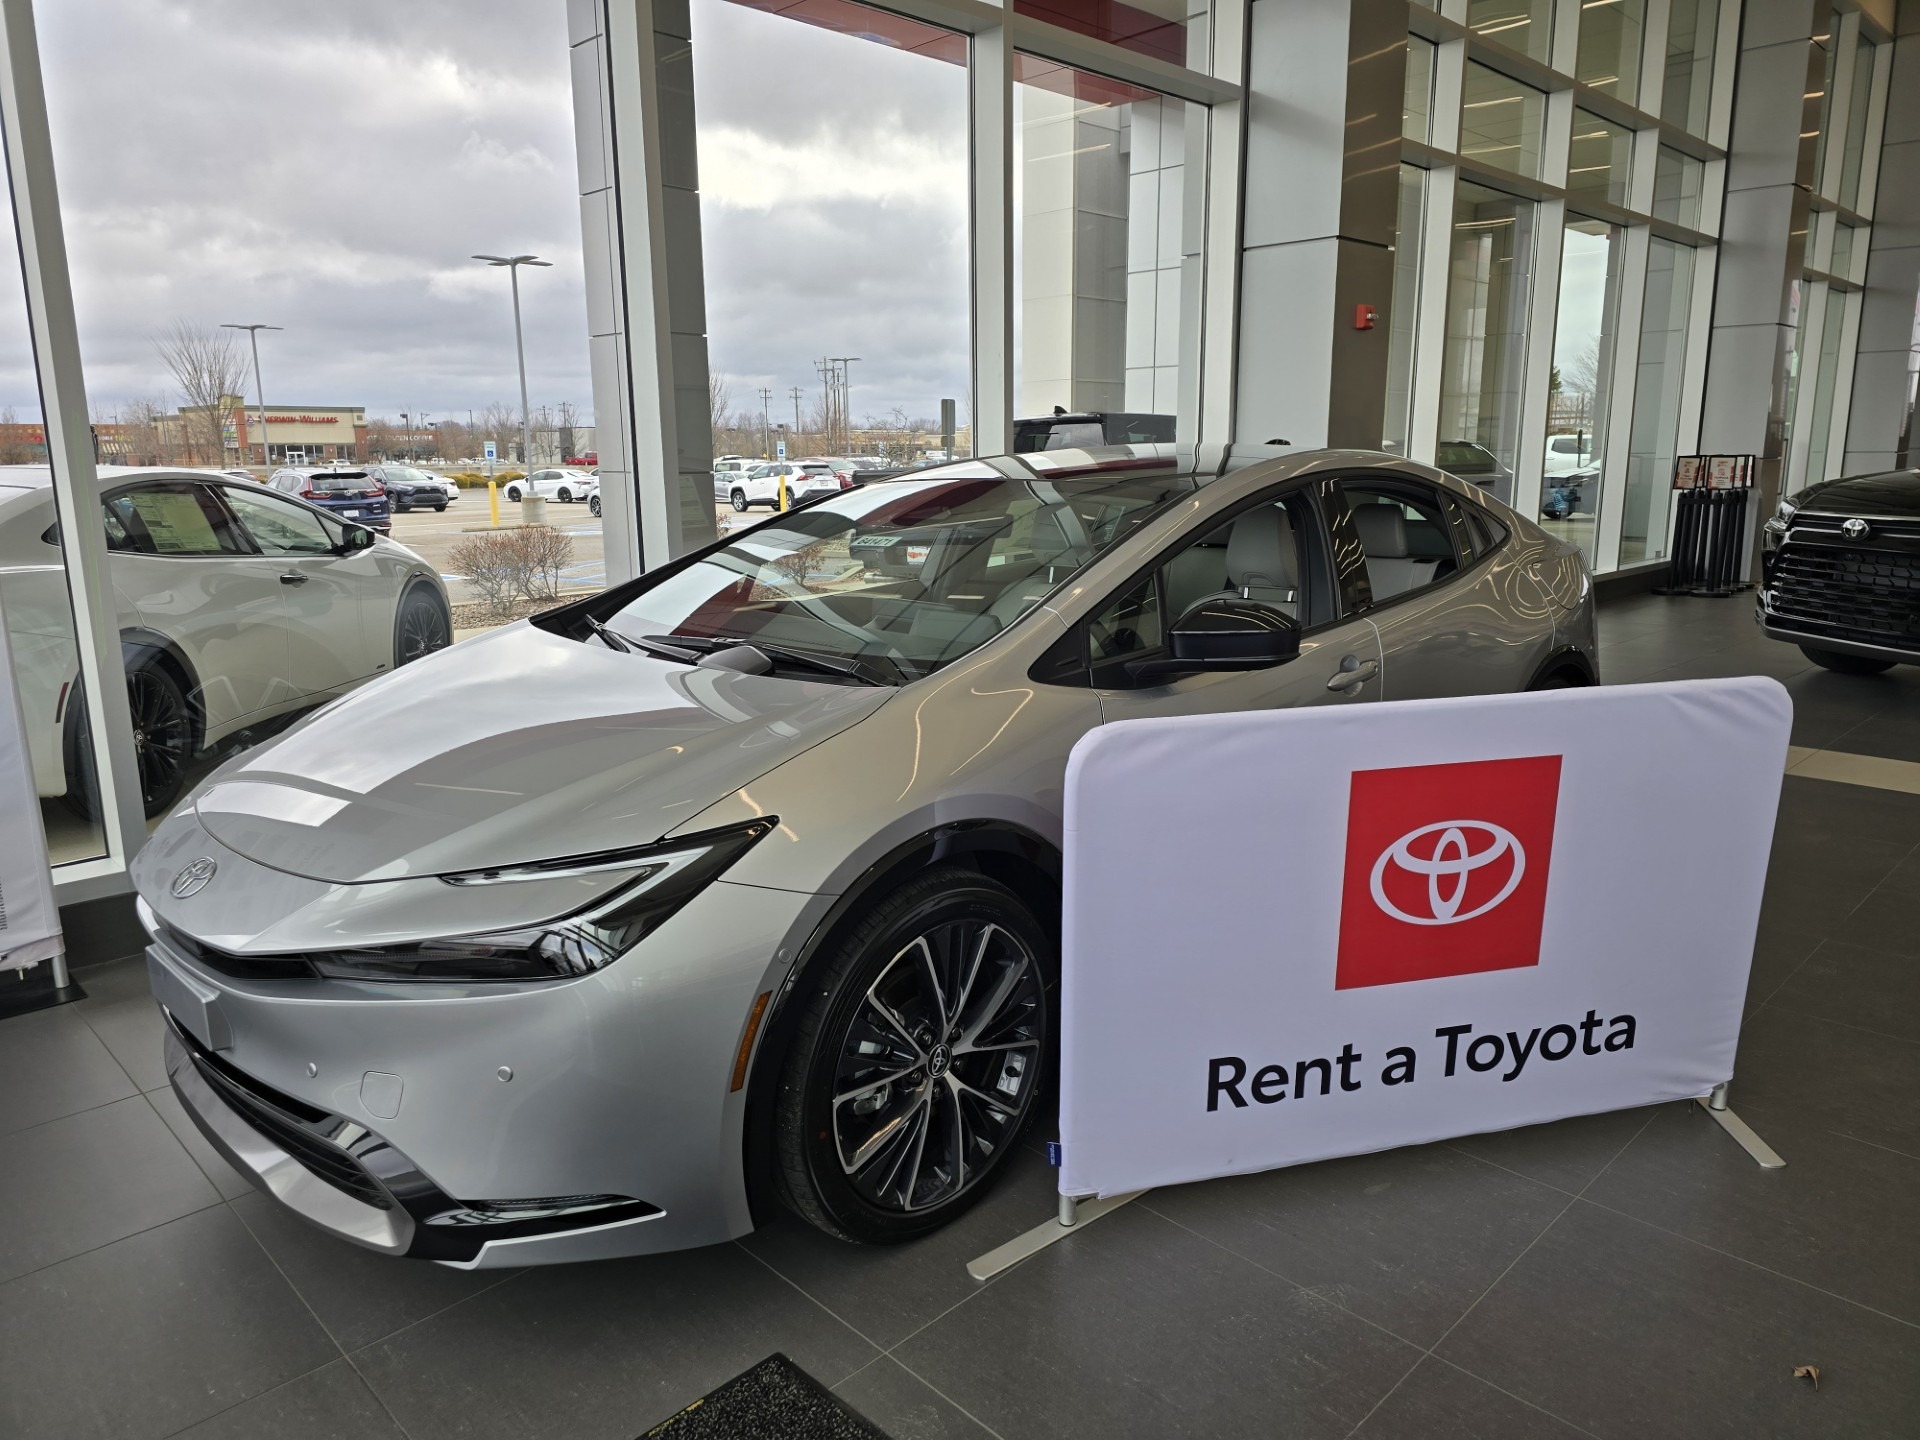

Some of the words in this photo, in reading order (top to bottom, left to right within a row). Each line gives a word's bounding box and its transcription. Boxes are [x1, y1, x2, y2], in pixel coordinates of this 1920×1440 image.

[1206, 1043, 1362, 1113] Rent
[1380, 1046, 1417, 1086] a
[1435, 1009, 1637, 1083] Toyota
